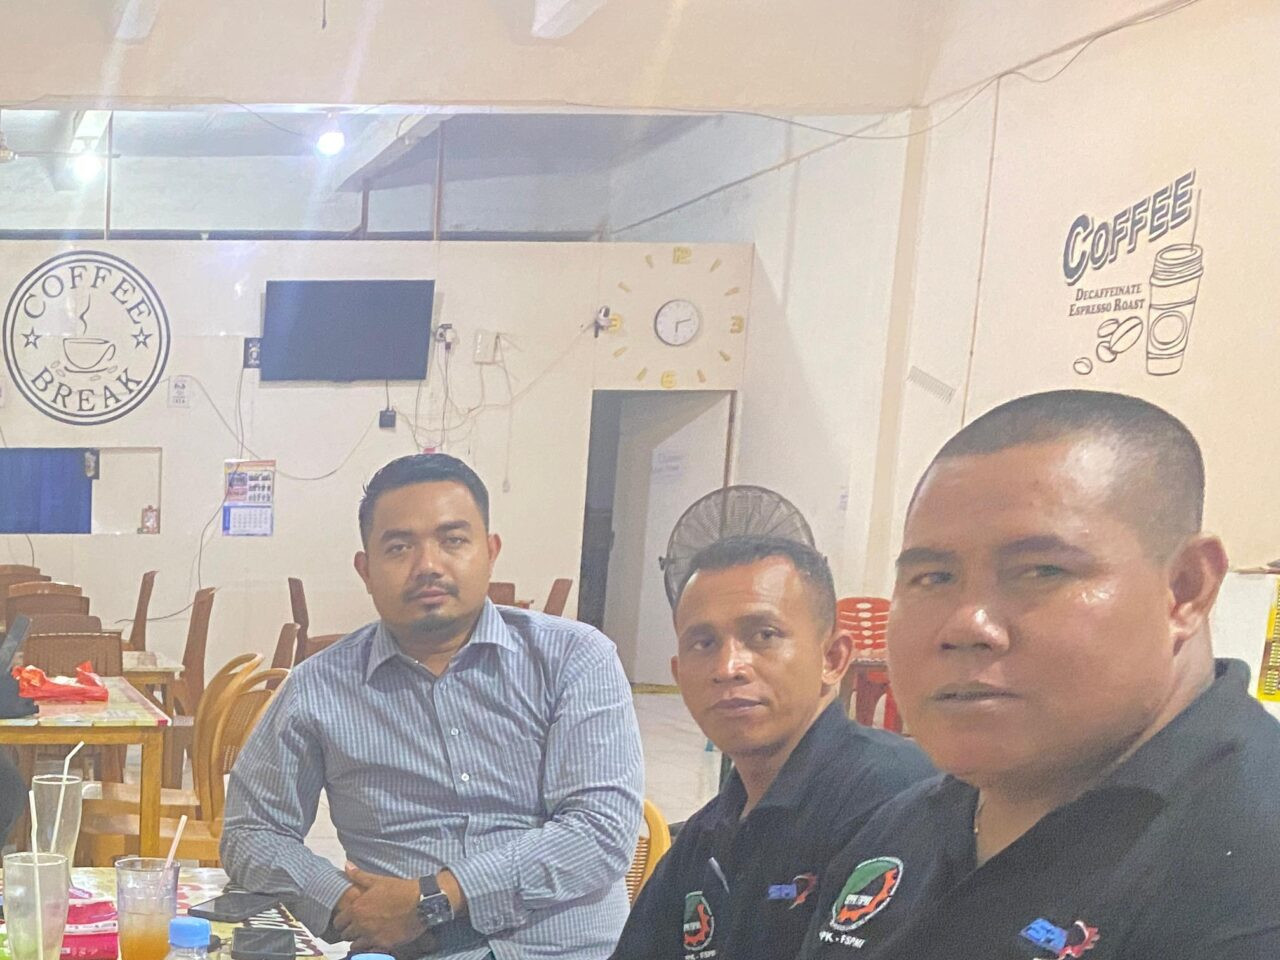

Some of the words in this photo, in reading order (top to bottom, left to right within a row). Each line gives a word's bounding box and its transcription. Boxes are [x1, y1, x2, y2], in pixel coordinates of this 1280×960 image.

[1063, 168, 1196, 286] COFFEE
[23, 264, 152, 324] COFFEE
[1069, 303, 1112, 316] ESPRESSO
[1113, 298, 1146, 312] ROAST
[1075, 283, 1143, 301] DECAFFEINATE
[730, 315, 744, 334] 3
[30, 366, 144, 412] BREAK
